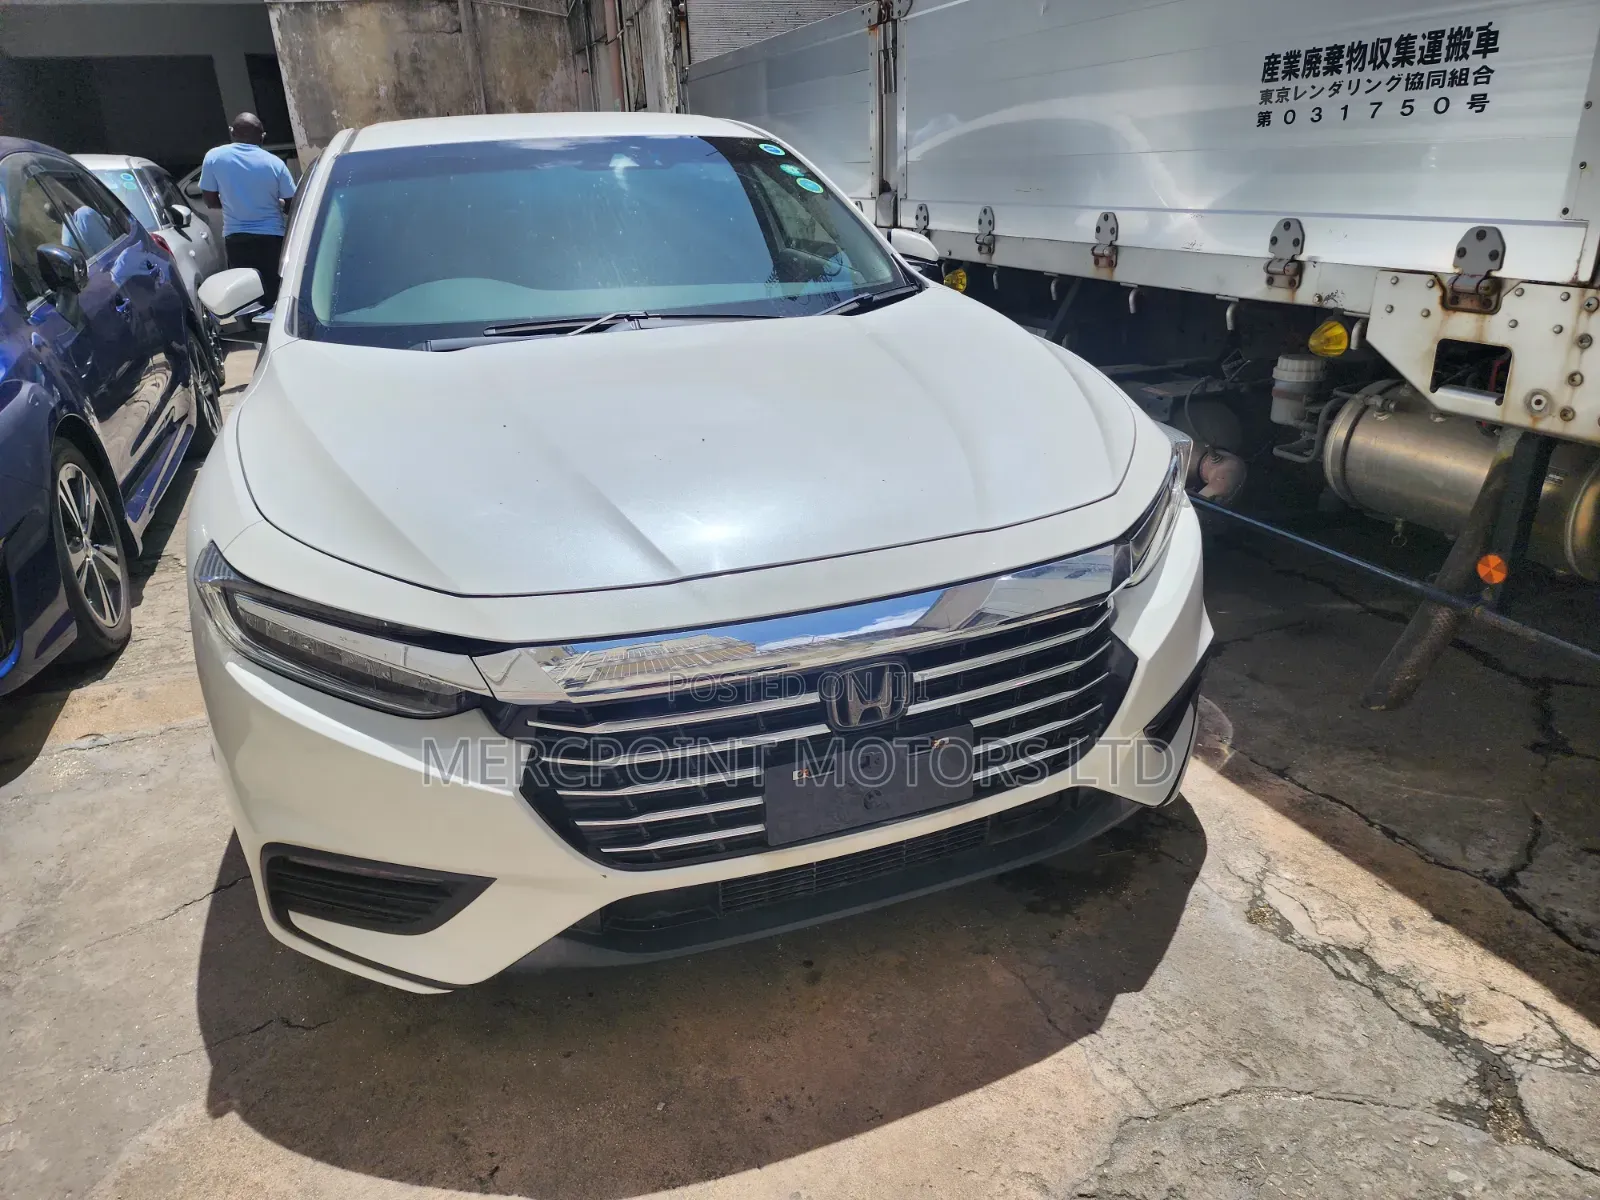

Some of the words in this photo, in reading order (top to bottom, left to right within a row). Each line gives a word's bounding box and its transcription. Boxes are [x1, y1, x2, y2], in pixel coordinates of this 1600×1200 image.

[1261, 21, 1499, 84] 産業廃棄物収集運搬車
[1258, 65, 1495, 106] 東京レンダリング協同組合
